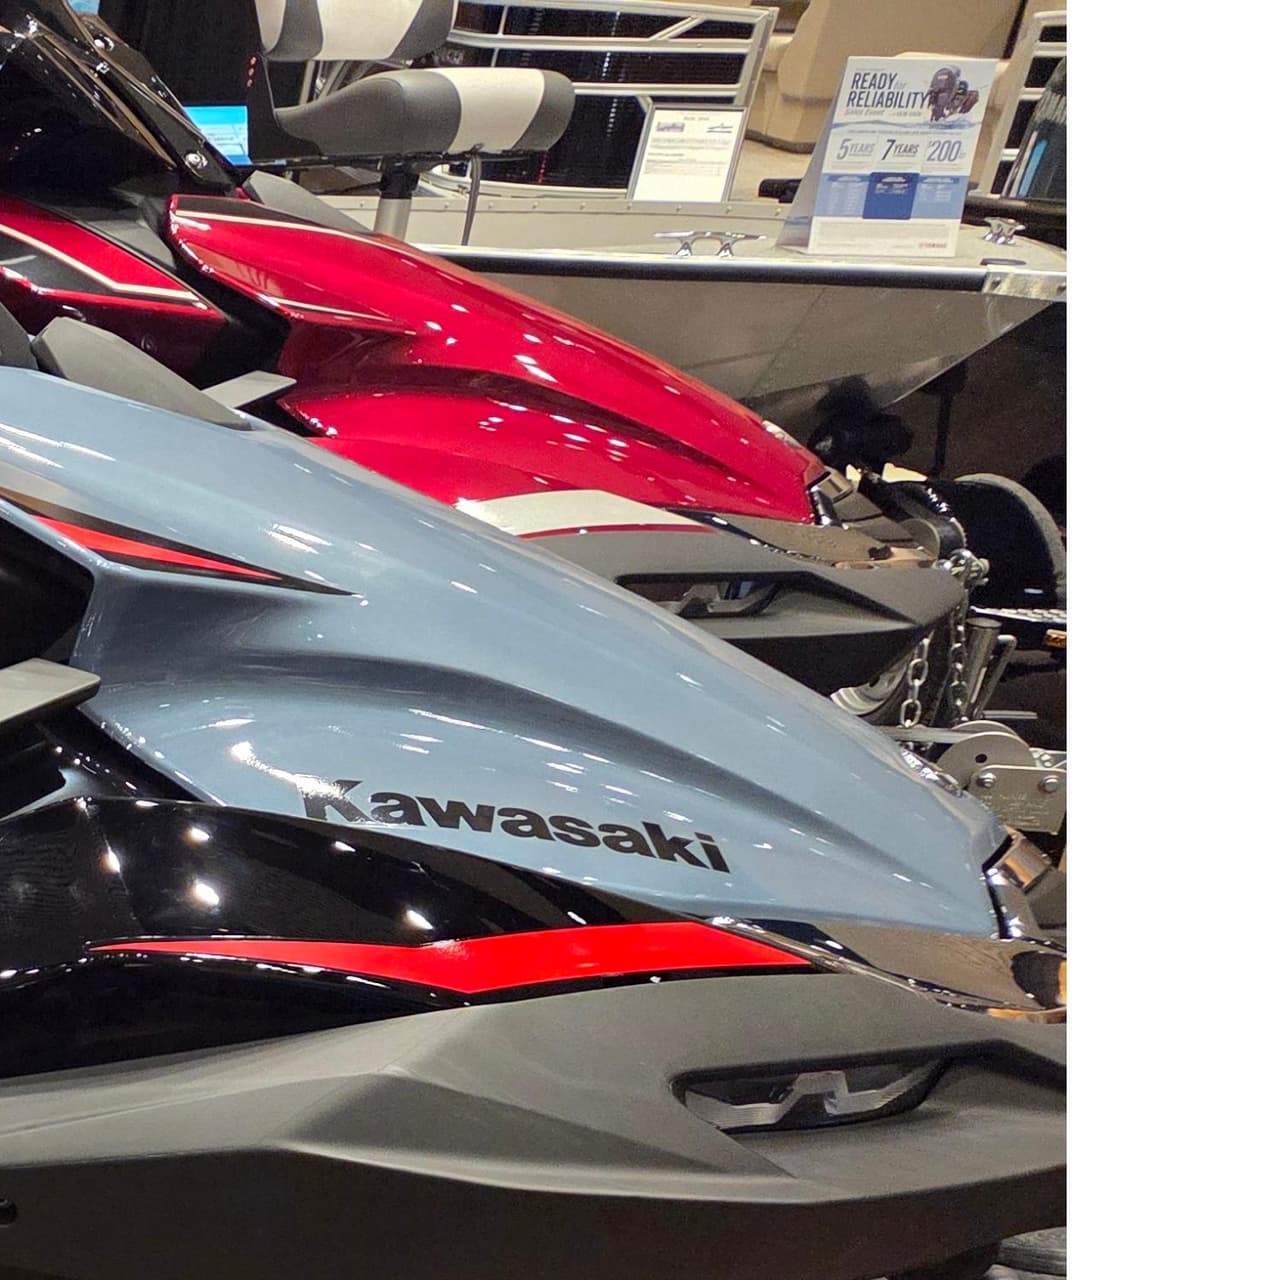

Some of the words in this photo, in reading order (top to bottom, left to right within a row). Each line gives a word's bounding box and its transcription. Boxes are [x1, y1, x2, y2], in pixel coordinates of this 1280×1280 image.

[851, 72, 898, 90] READY
[846, 91, 930, 109] RELIABILITY
[881, 139, 896, 160] 7
[894, 144, 919, 154] YEARS
[295, 779, 731, 874] Kawasaki
